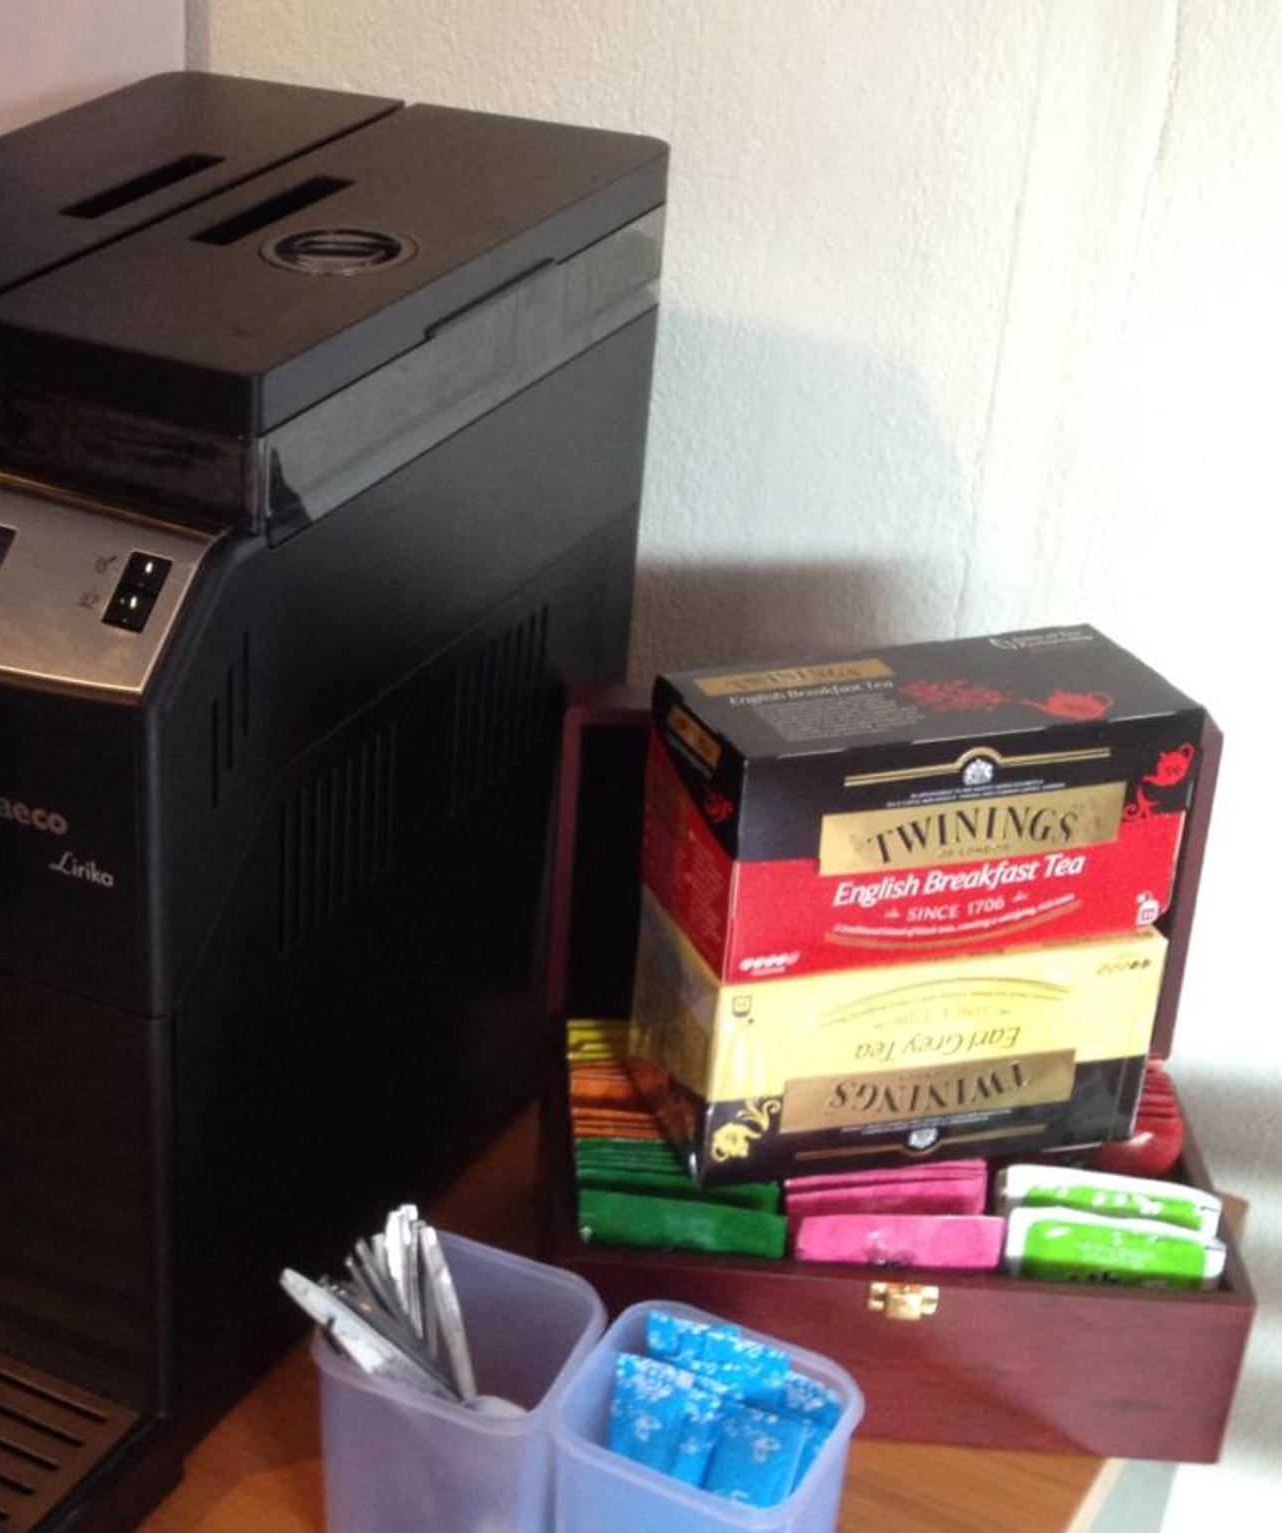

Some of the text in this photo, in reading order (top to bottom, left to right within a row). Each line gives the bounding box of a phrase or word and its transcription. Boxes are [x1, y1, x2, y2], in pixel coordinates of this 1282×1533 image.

[729, 680, 894, 708] English Breakfast Tea
[867, 805, 1079, 864] TWININGS
[49, 851, 114, 887] Lirika
[832, 852, 1087, 908] English Breakfast Tea
[905, 895, 1006, 922] SINCE 1706
[854, 1025, 1021, 1063] Earl Grey Tea
[829, 1061, 1027, 1113] TWININGS
